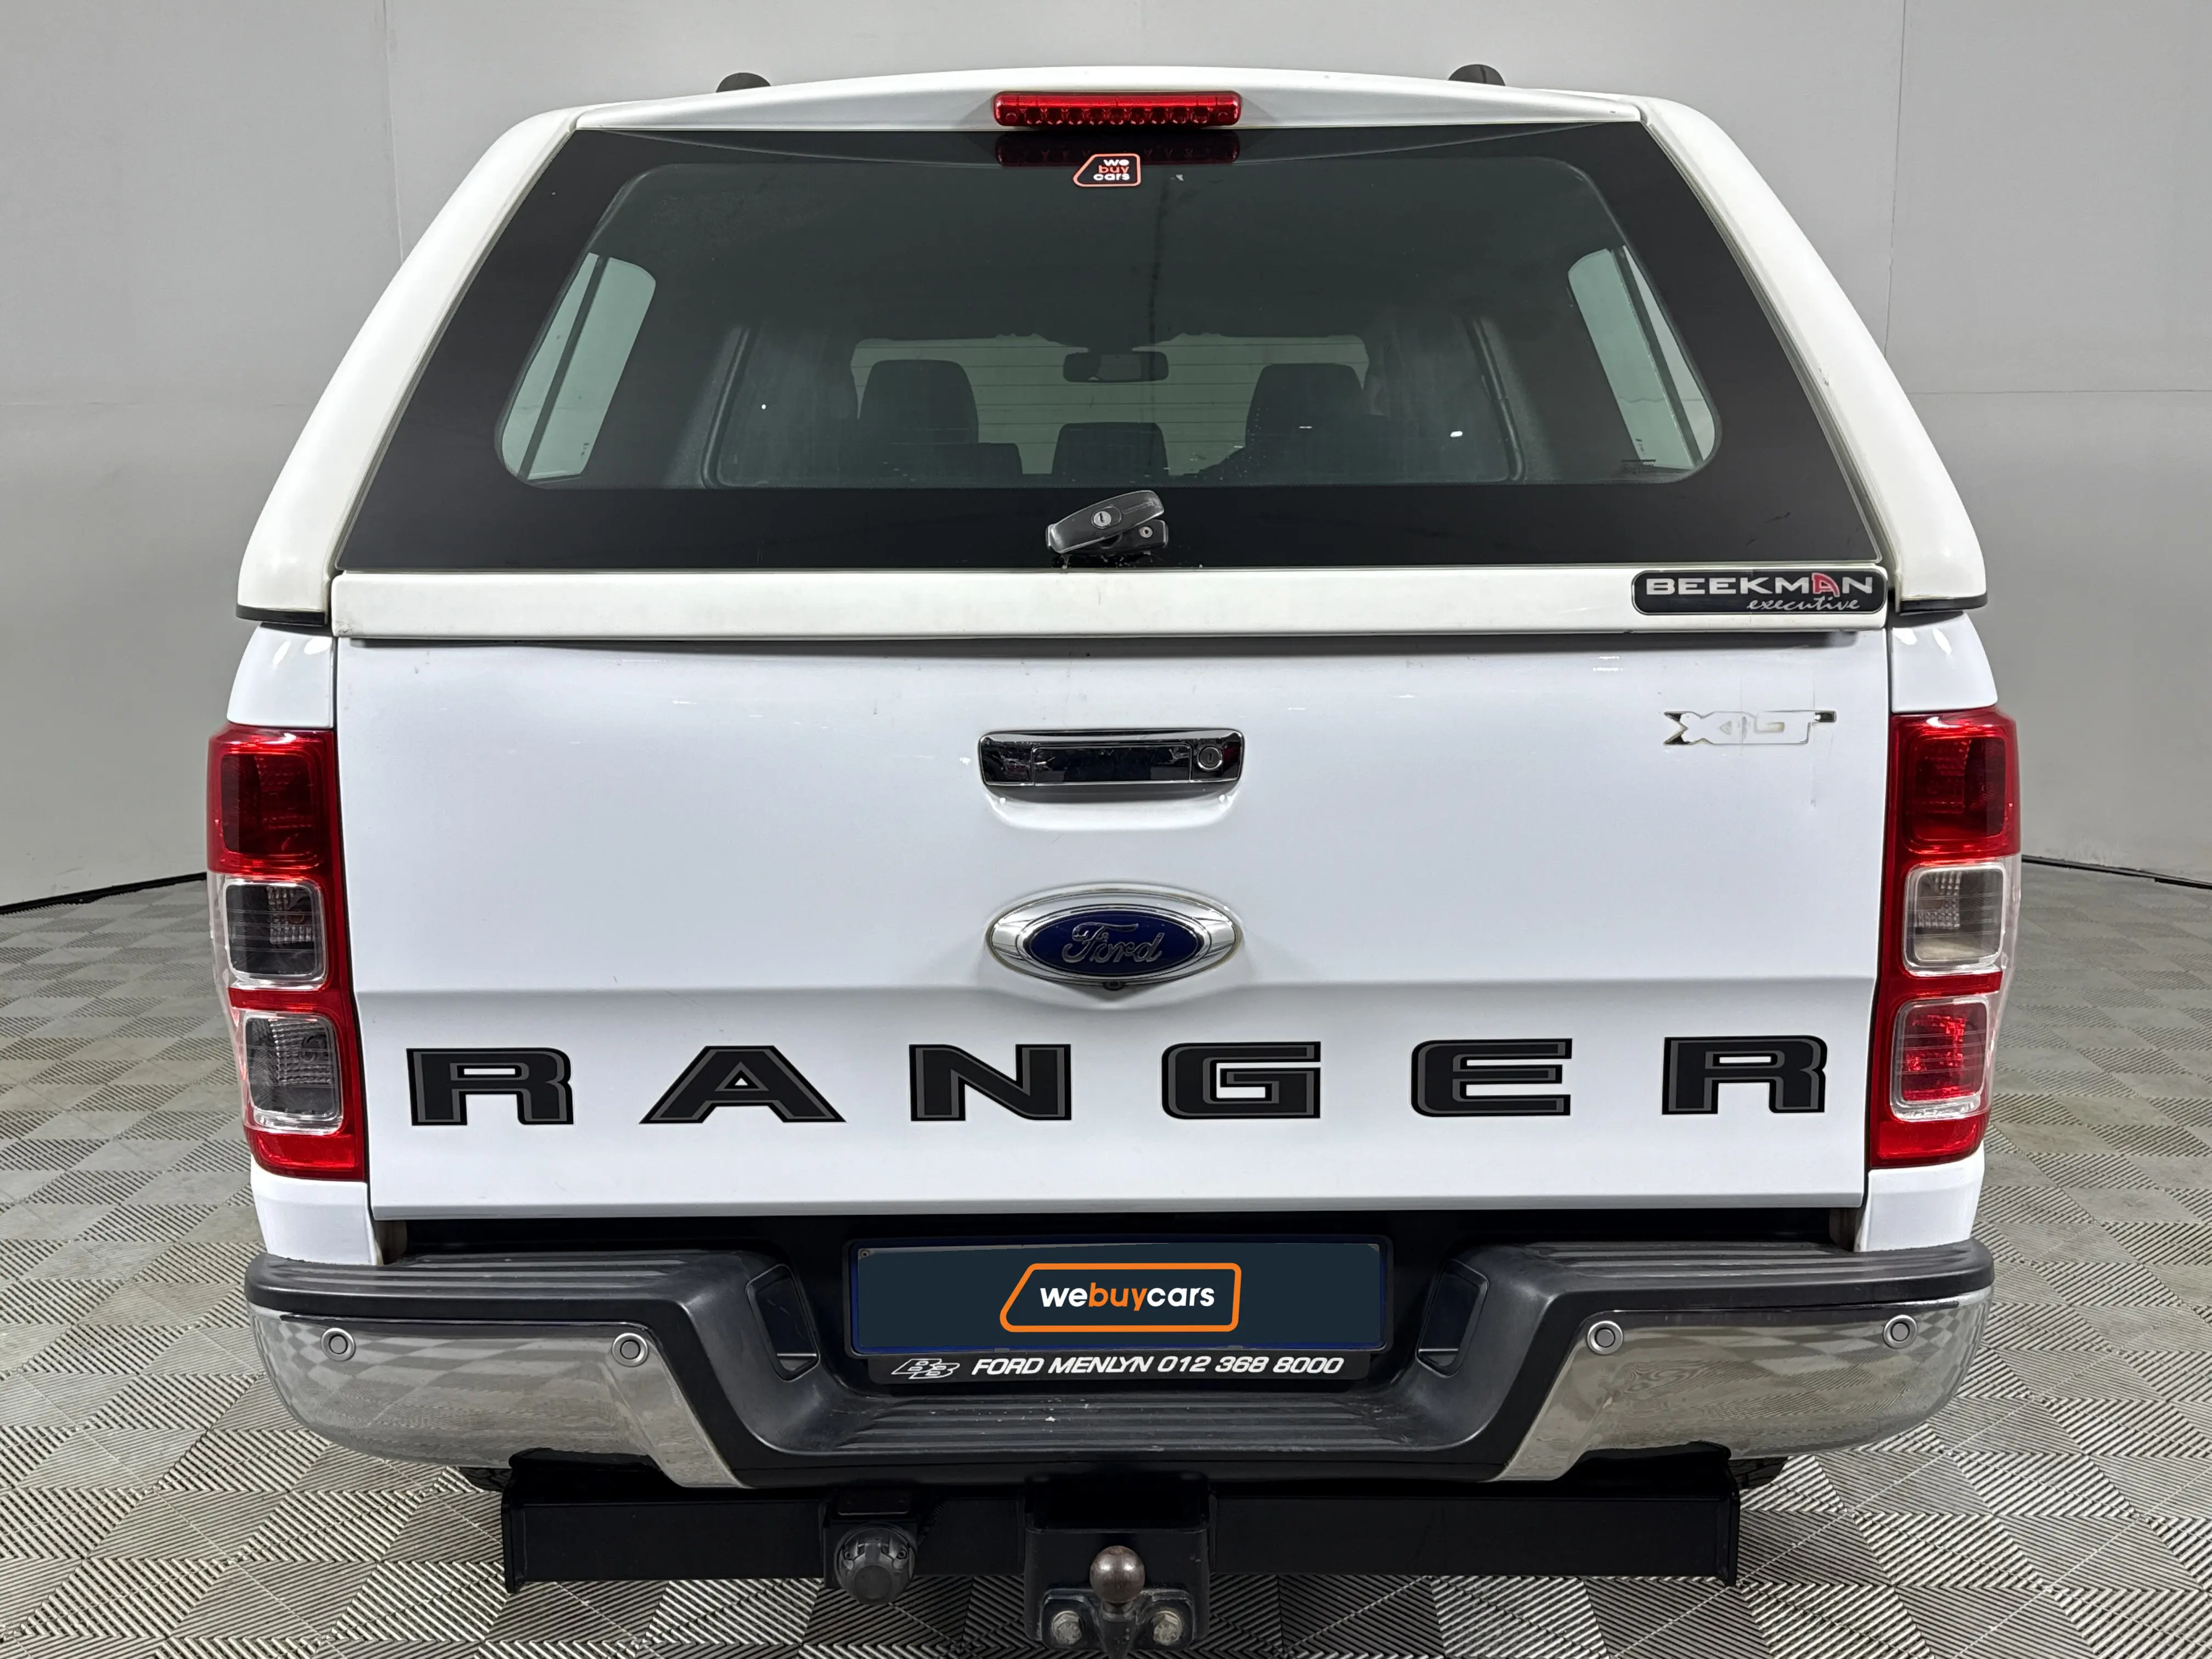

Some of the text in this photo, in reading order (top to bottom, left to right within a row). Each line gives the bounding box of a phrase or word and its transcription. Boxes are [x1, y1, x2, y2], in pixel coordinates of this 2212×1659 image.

[1098, 165, 1130, 173] buy
[1646, 572, 1873, 597] BEEKMAN
[1746, 595, 1860, 611] executive
[1062, 922, 1165, 963] Ford
[406, 1036, 1828, 1126] RANGER
[971, 1358, 1045, 1375] FORD
[1047, 1356, 1154, 1374] MENLYN
[1157, 1356, 1212, 1372] 012
[1215, 1356, 1269, 1373] 368
[1272, 1356, 1344, 1374] 8000
